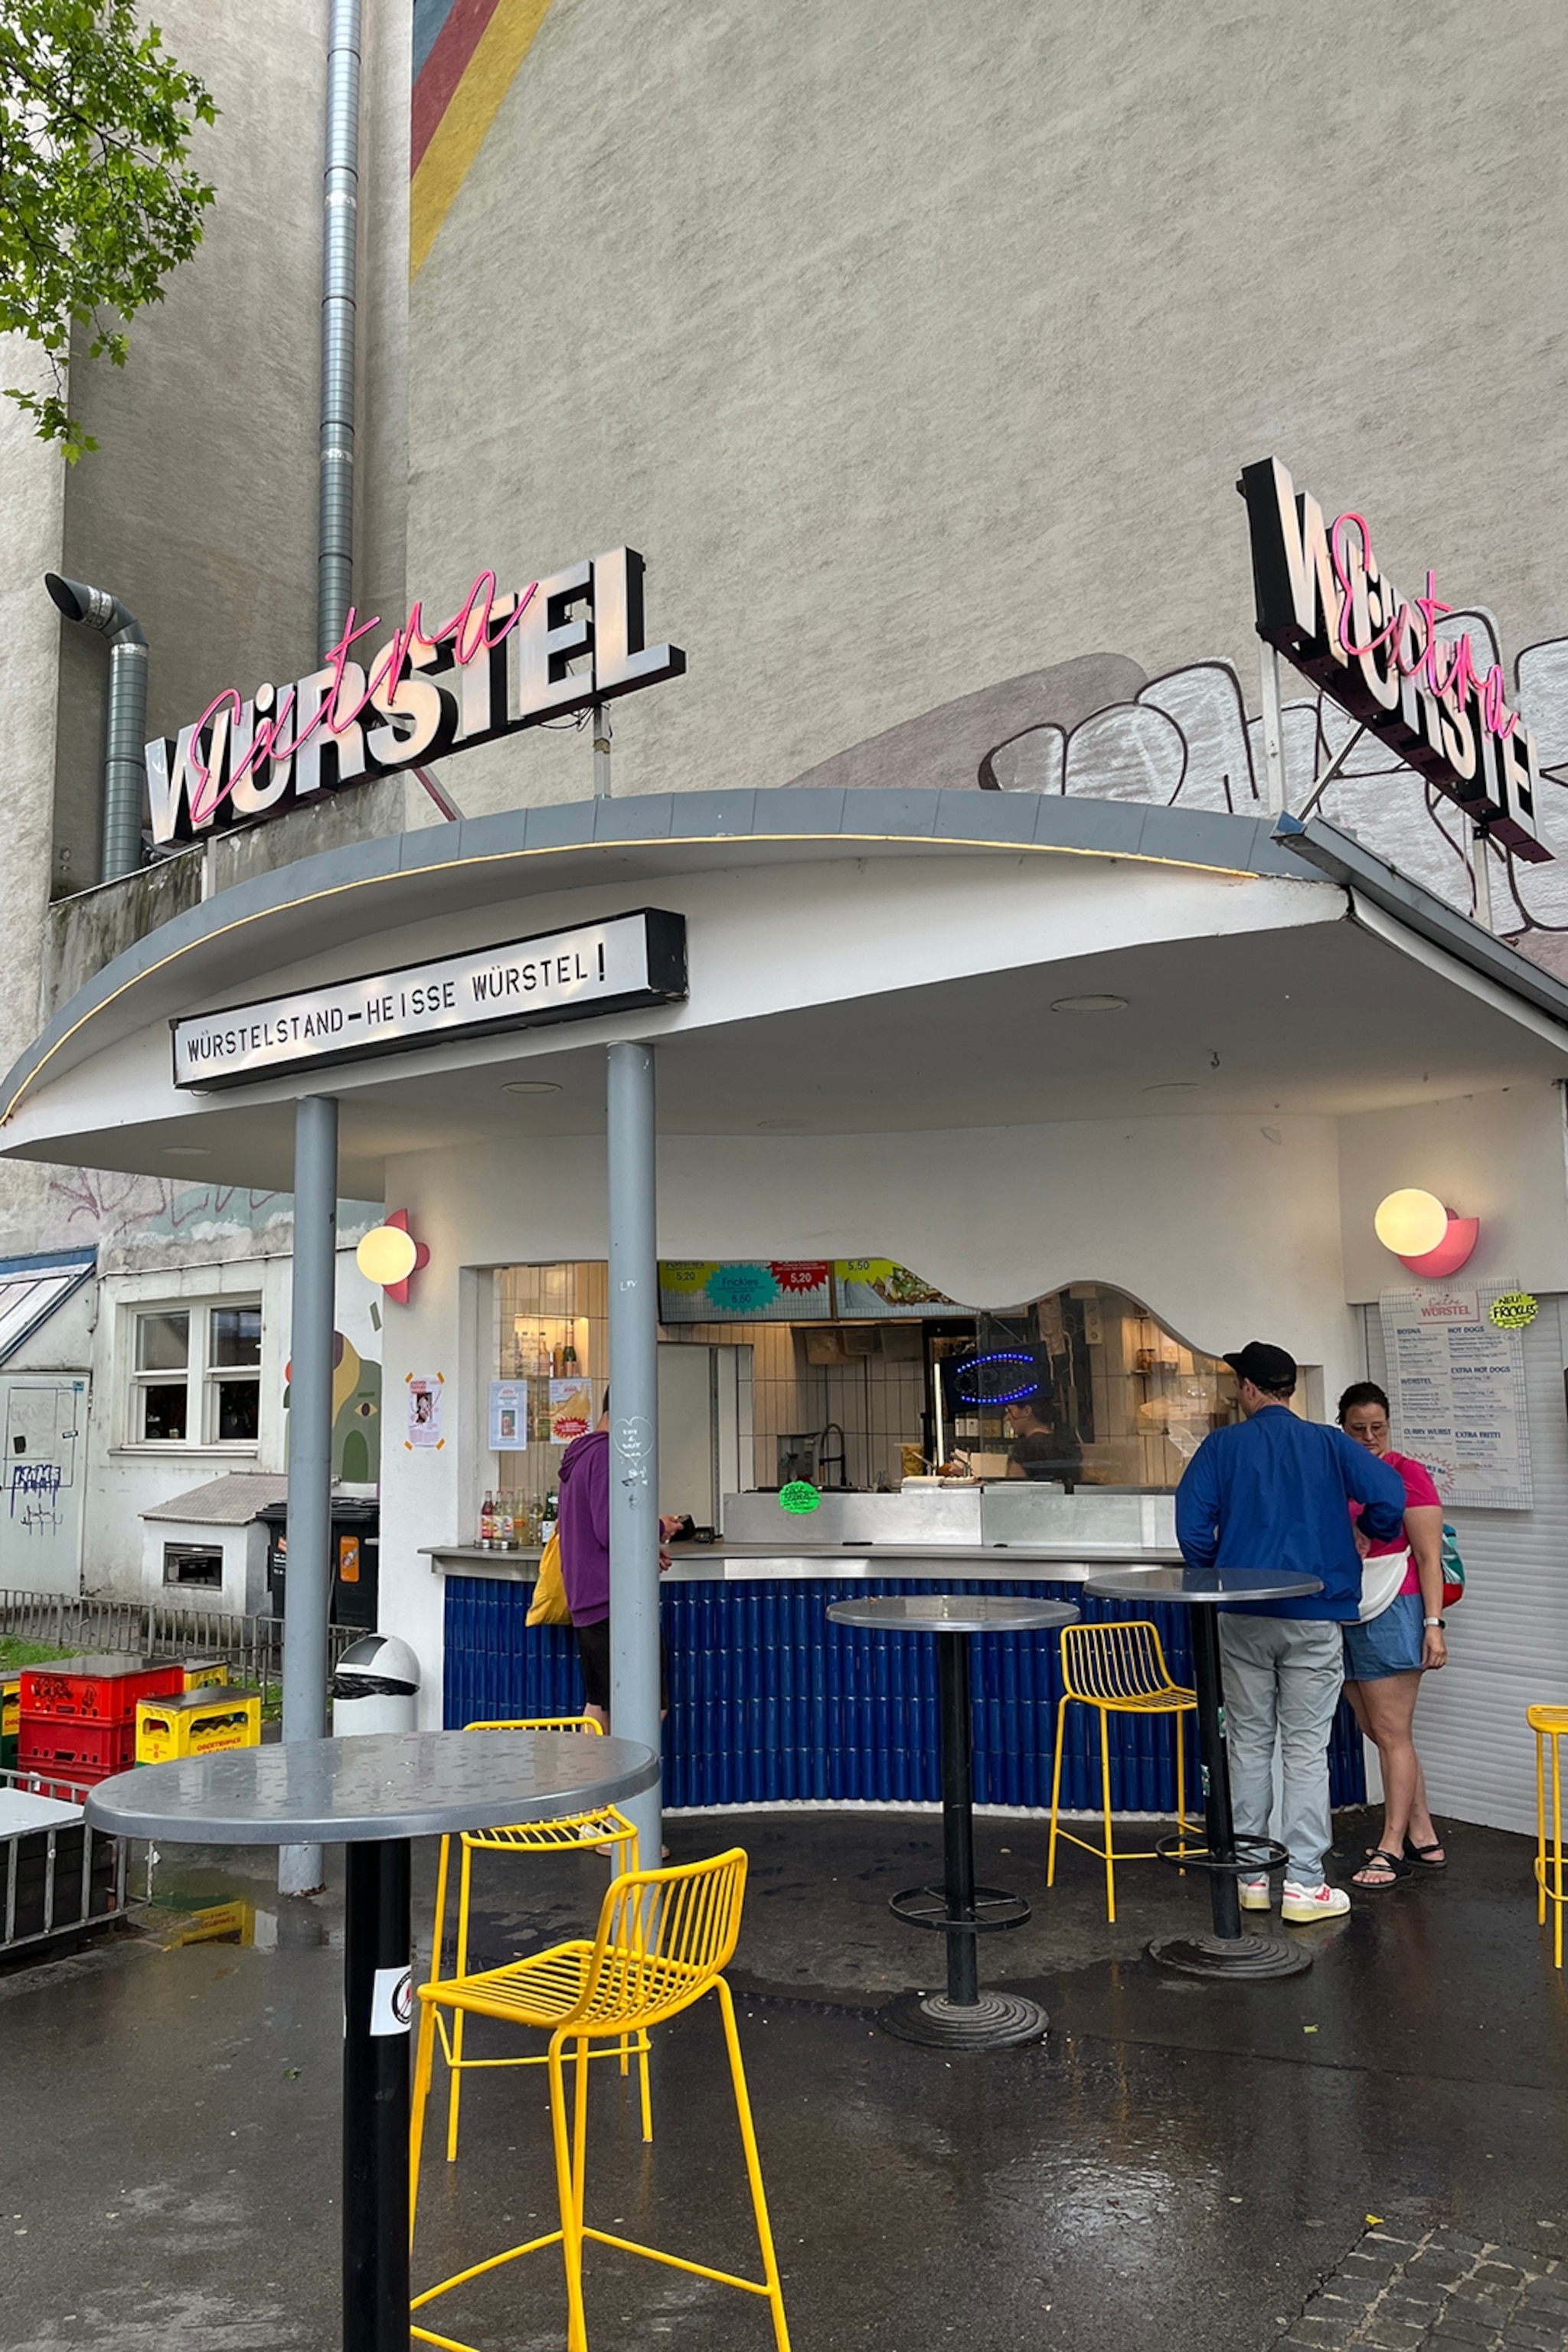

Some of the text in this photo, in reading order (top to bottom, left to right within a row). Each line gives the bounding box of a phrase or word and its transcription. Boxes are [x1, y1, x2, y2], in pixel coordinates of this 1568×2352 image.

[190, 569, 538, 824] Extra
[472, 942, 606, 1001] WÜRSTEL!
[722, 1277, 759, 1287] Frickles
[790, 1272, 812, 1283] 5,20
